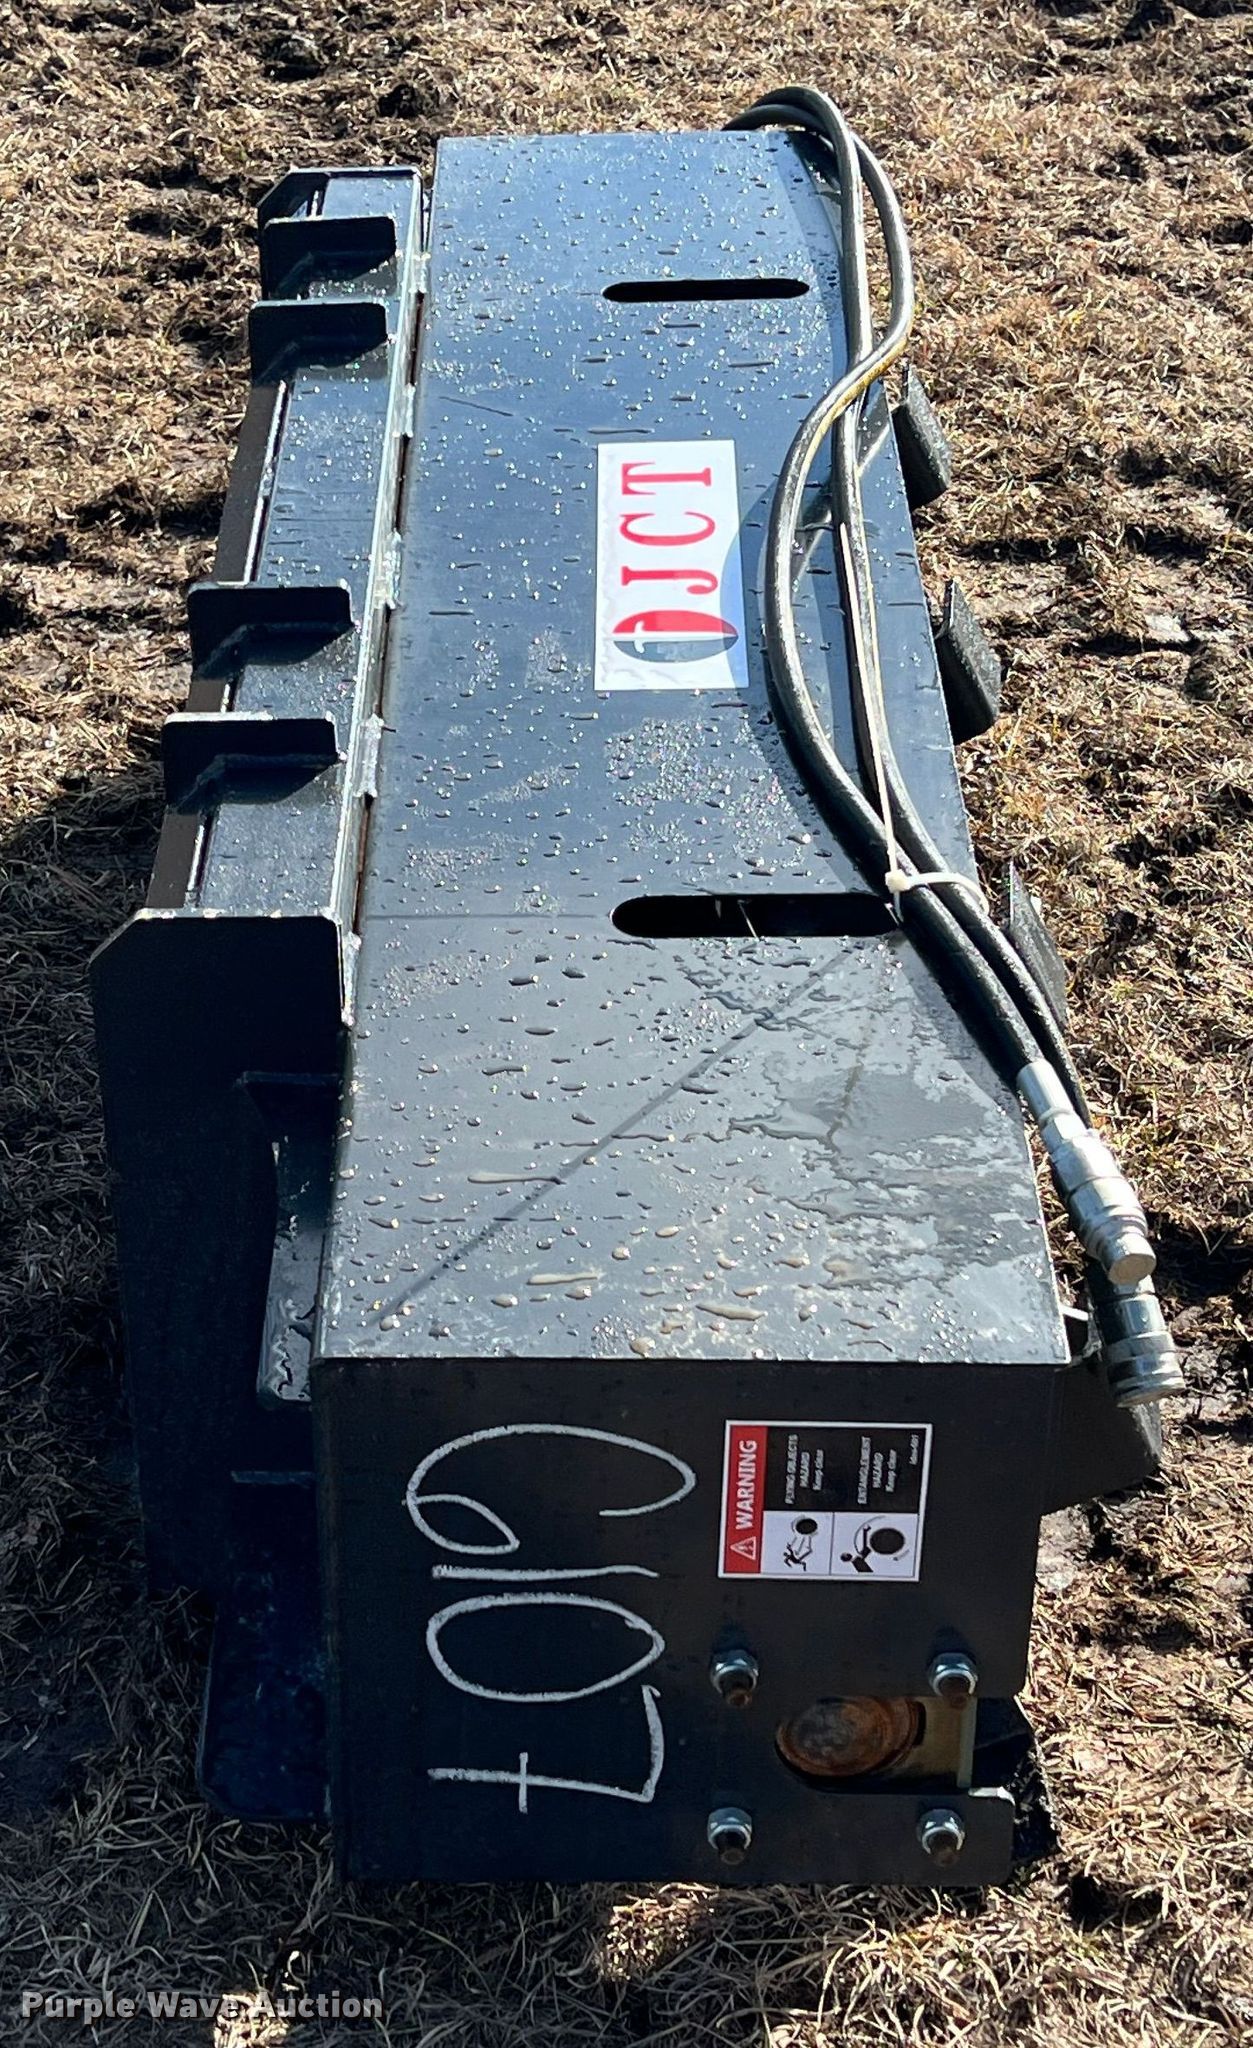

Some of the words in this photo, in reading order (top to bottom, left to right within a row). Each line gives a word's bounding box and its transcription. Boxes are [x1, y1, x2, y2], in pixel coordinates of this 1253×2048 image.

[619, 461, 719, 595] JCT
[786, 1434, 799, 1473] OBJECTS
[799, 1451, 811, 1488] HAZARD
[814, 1449, 824, 1469] clear
[857, 1436, 871, 1505] ENTANGLEMENT
[872, 1452, 884, 1489] HAZARD
[886, 1449, 898, 1469] clear
[735, 1440, 758, 1530] WARNING
[785, 1474, 796, 1504] FLYING
[813, 1470, 824, 1491] Keep
[885, 1471, 897, 1493] Keep
